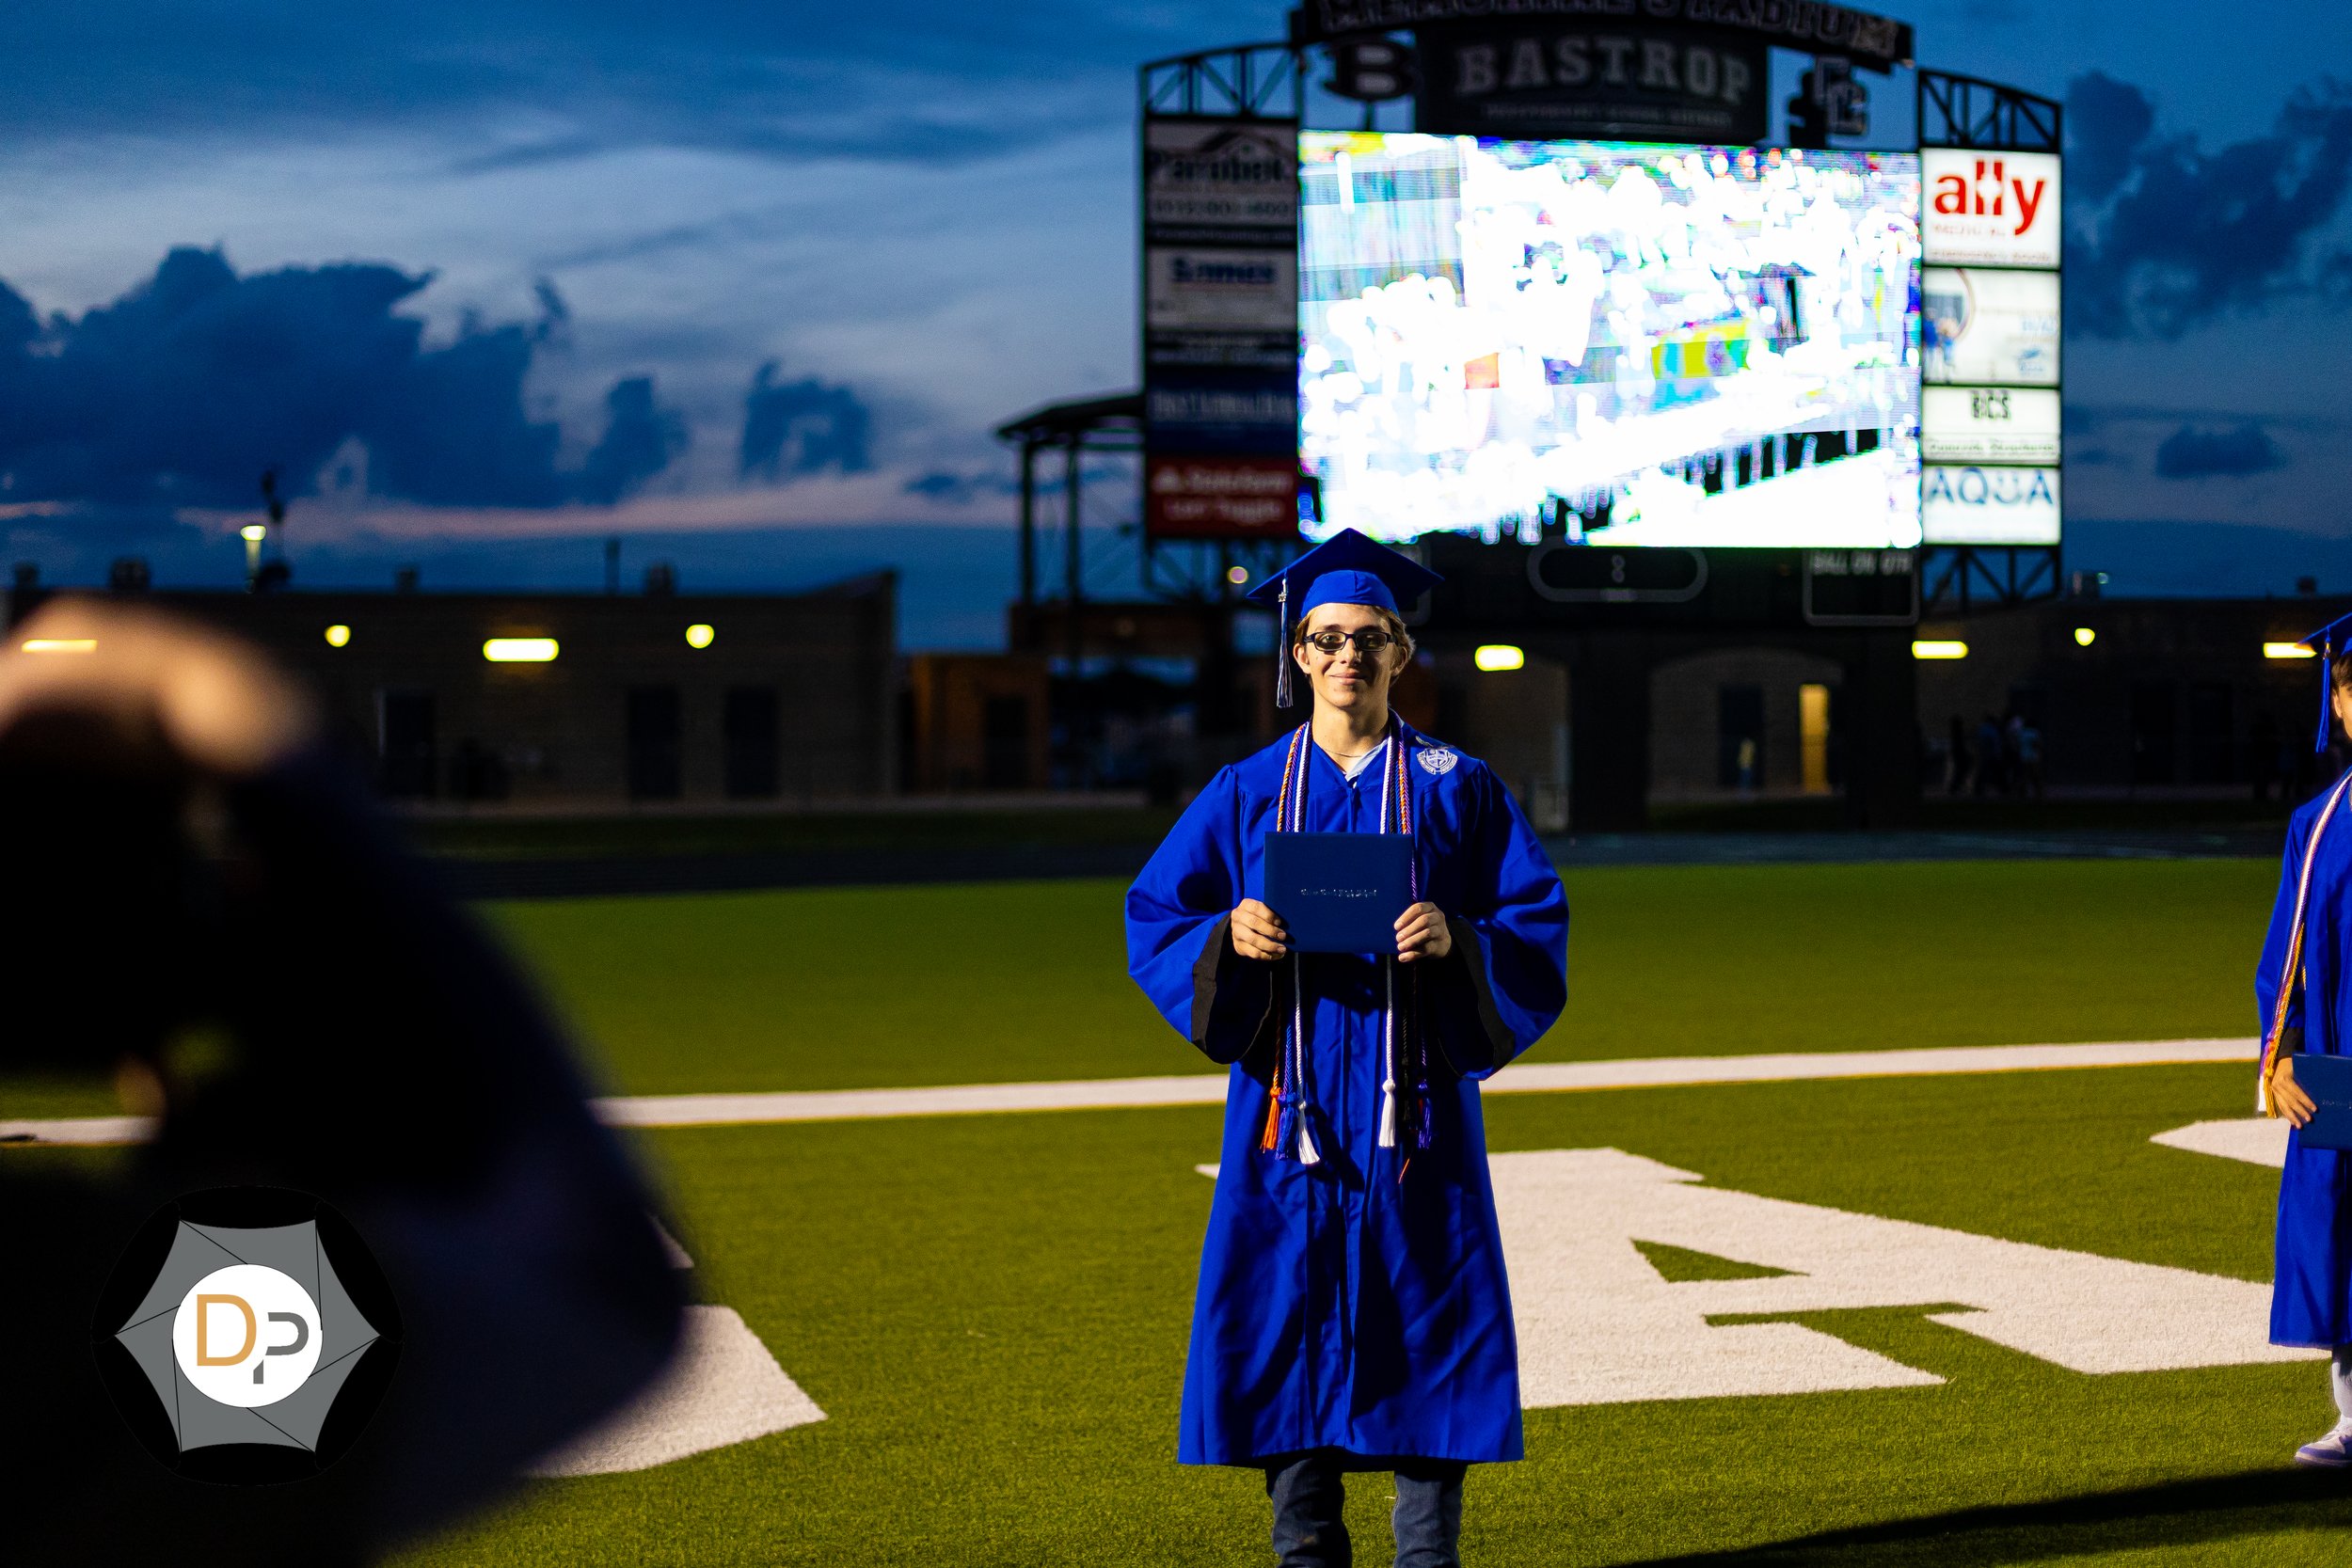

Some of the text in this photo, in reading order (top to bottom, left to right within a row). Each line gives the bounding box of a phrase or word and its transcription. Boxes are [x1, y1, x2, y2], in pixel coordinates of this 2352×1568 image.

[1323, 39, 1413, 99] B
[1452, 34, 1752, 105] BASTROP
[1933, 159, 2045, 236] ally
[1928, 467, 2053, 505] AQUA
